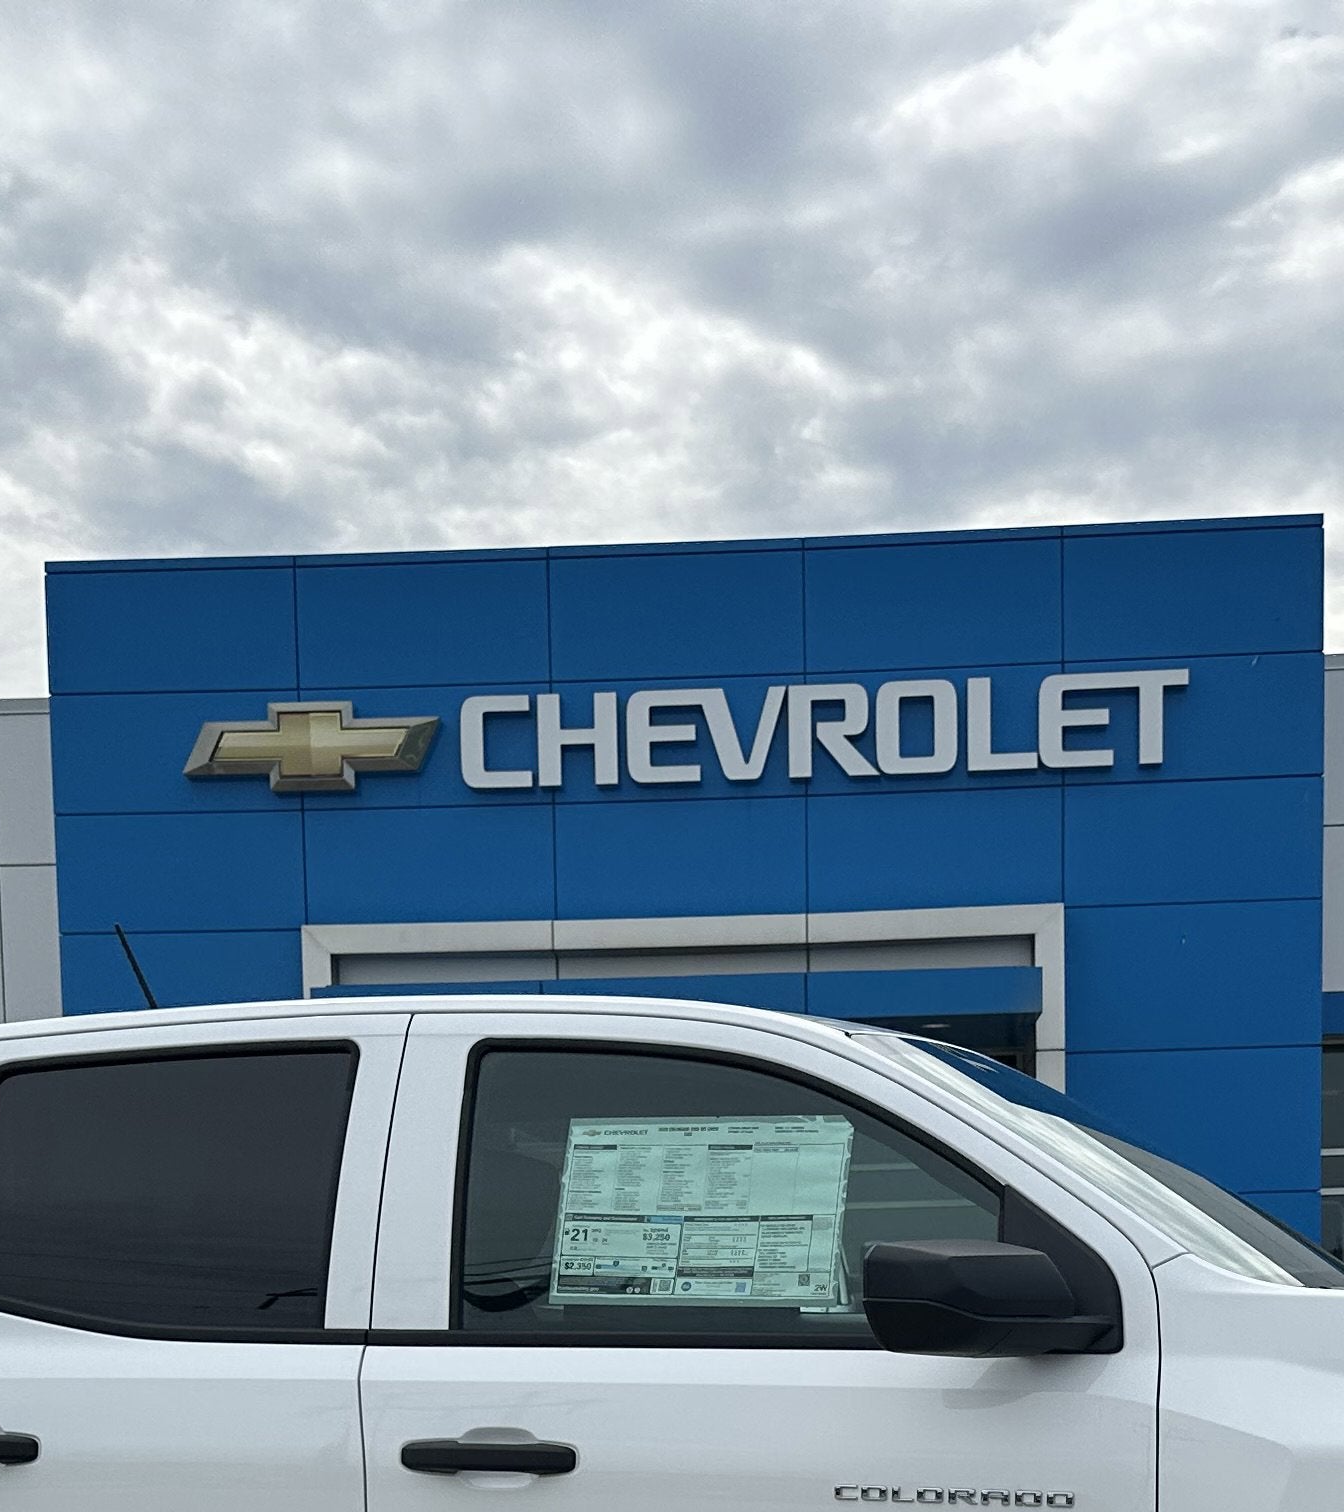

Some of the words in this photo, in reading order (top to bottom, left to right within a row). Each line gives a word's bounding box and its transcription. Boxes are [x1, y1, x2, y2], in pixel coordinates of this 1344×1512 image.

[460, 668, 1190, 789] CHEVROLET
[570, 1228, 589, 1242] 21
[834, 1484, 1075, 1508] COLORADO
